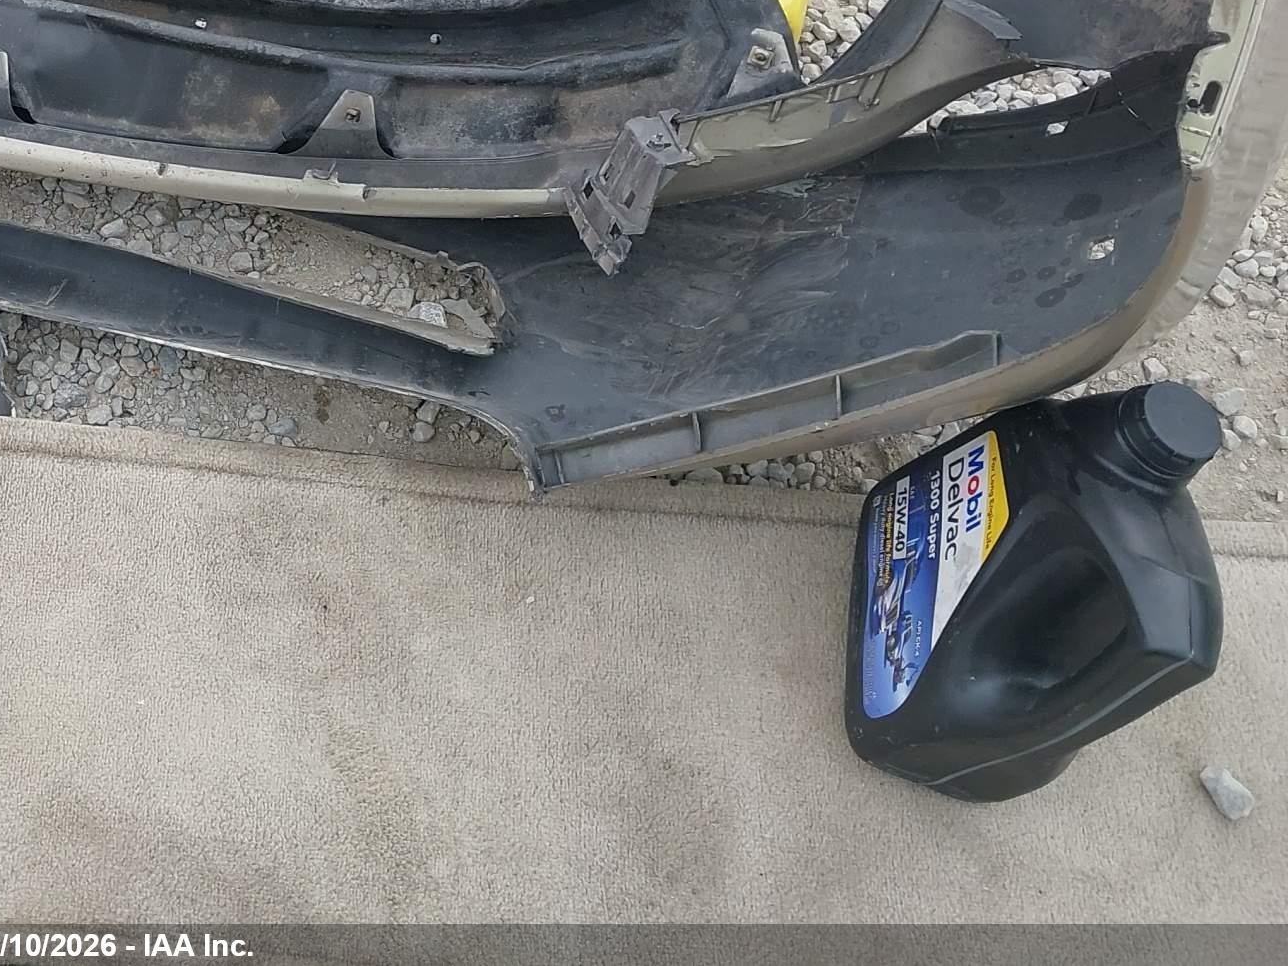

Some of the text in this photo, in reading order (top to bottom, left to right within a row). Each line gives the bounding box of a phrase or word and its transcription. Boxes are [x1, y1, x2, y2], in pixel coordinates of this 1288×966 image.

[894, 487, 908, 552] 15W-40
[927, 470, 941, 558] 1300 Super
[944, 456, 965, 561] Delvac
[965, 445, 985, 533] Mobil
